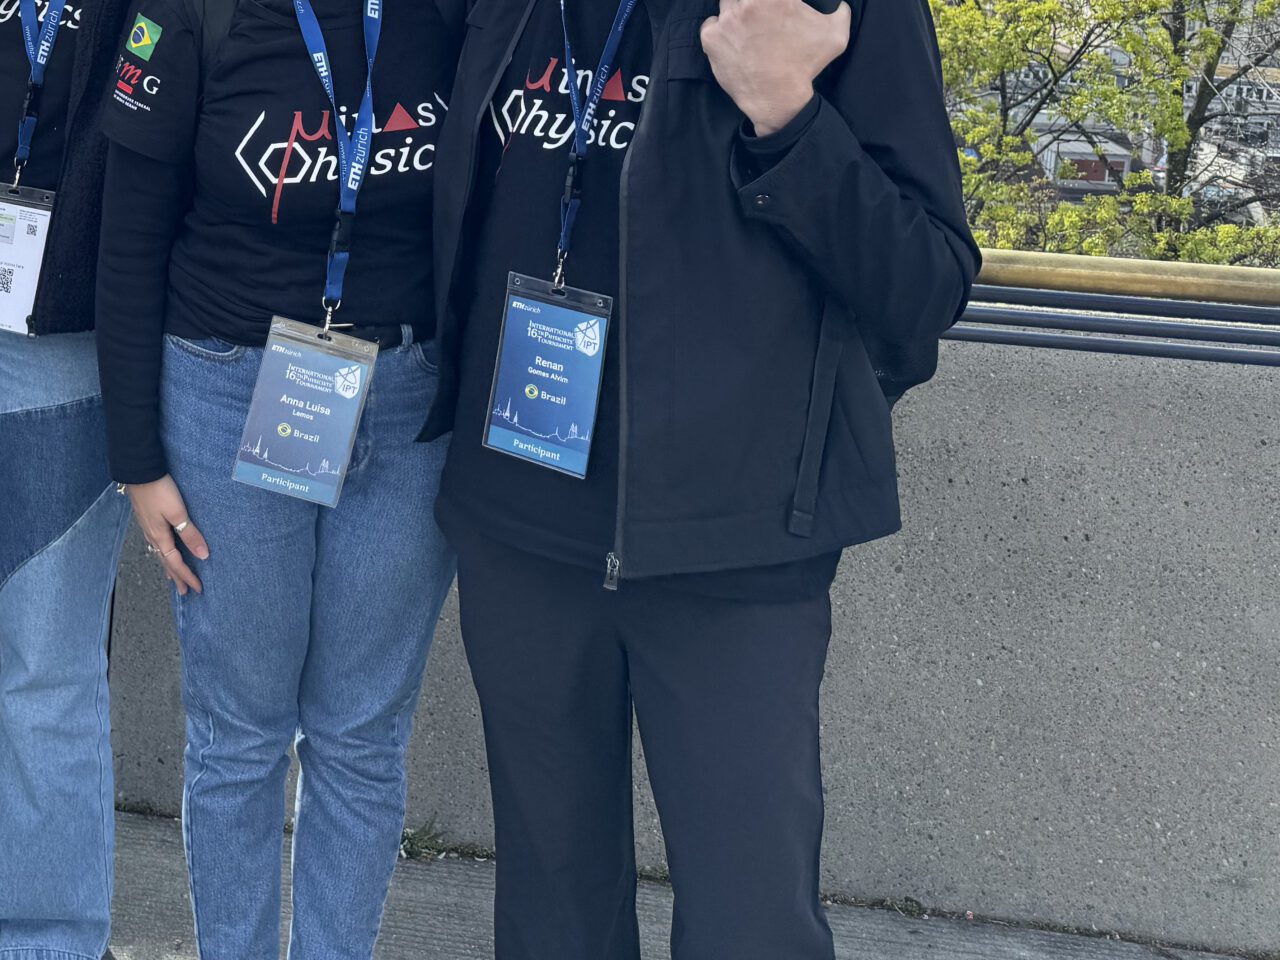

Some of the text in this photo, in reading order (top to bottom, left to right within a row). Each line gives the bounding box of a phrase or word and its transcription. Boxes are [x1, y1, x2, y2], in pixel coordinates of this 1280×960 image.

[583, 340, 598, 351] IPT
[535, 355, 564, 372] Renan
[527, 366, 550, 378] Gomes
[341, 384, 358, 395] IPT
[280, 394, 331, 416] Anna Luisa
[541, 391, 567, 406] Brazil
[292, 409, 314, 421] Lemos
[293, 429, 320, 443] Brazil
[513, 439, 560, 461] Participant
[261, 472, 310, 493] Participant
